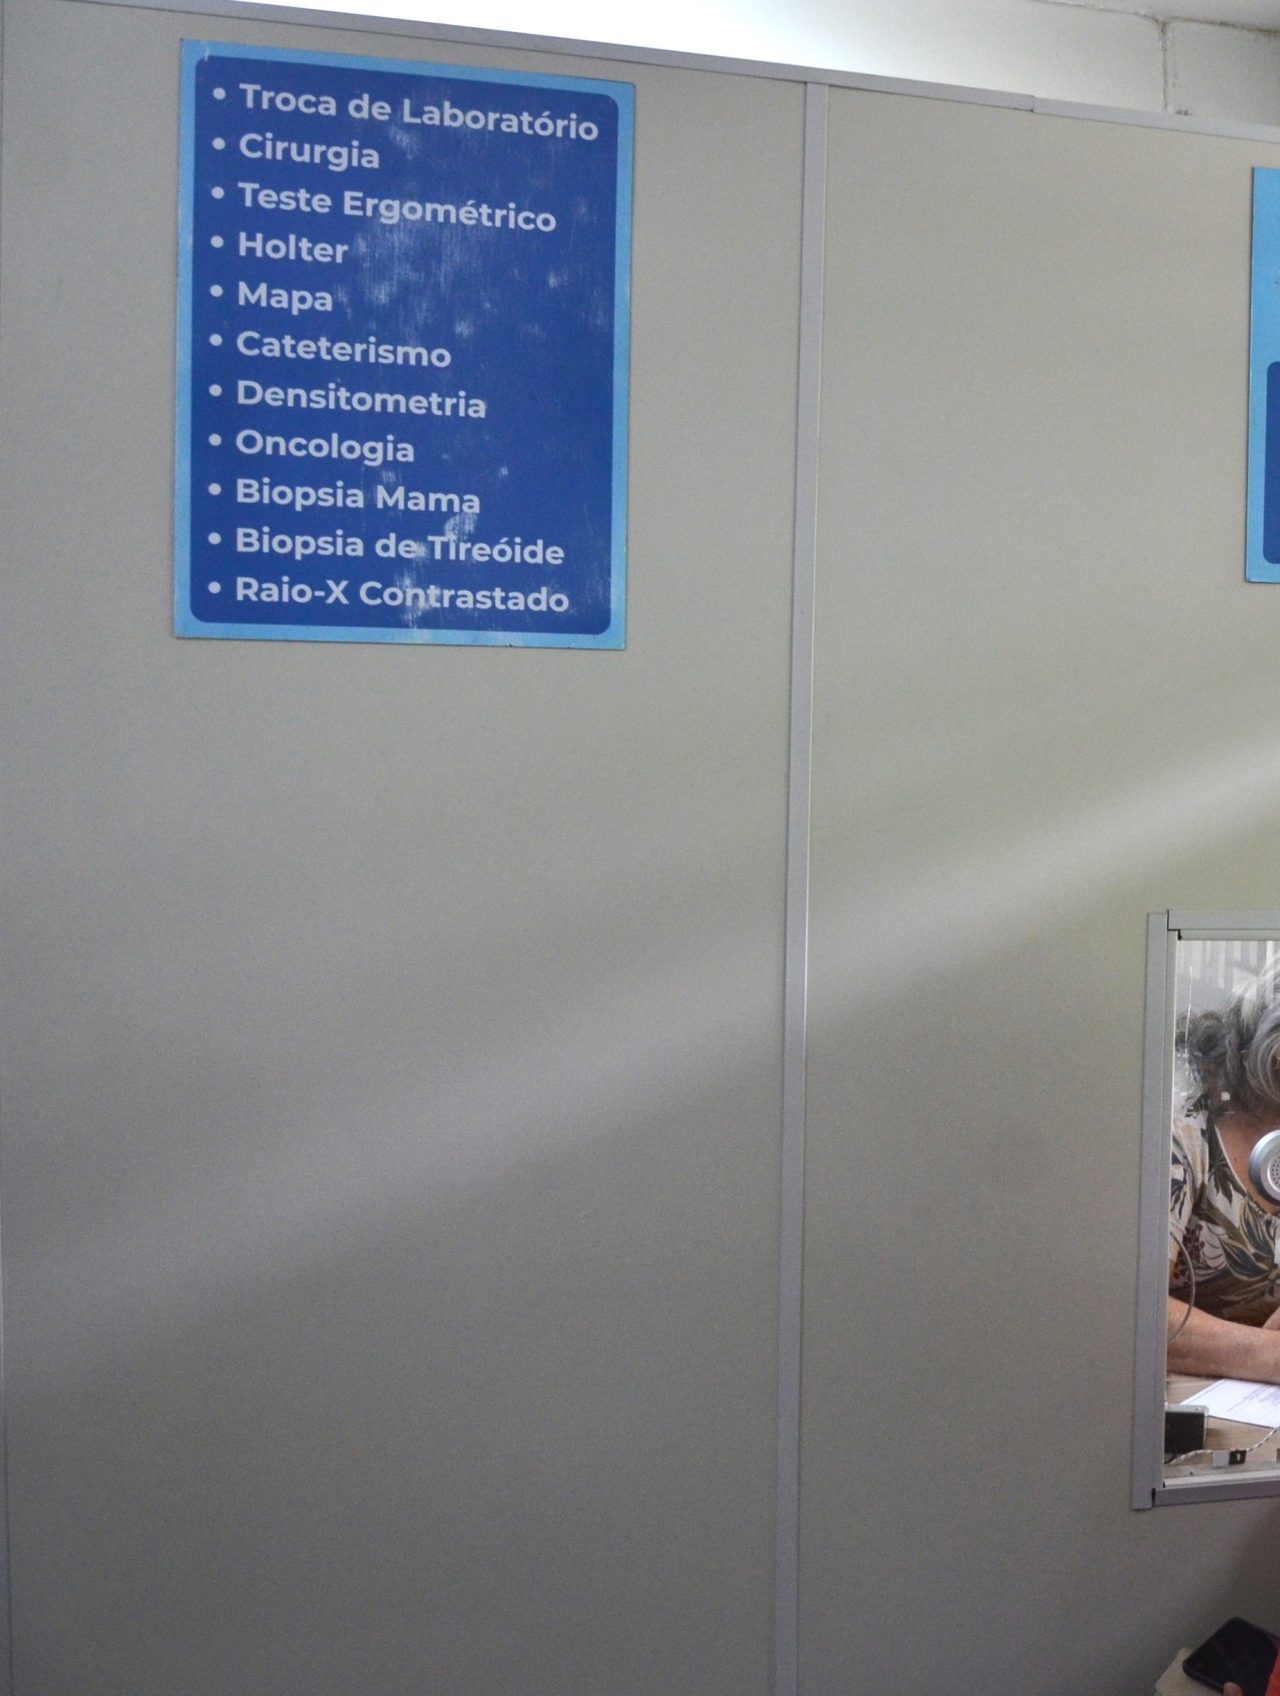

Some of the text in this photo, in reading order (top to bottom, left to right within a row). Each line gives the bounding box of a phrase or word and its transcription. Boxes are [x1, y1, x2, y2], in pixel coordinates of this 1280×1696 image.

[238, 83, 600, 141] Troca de Laboratório
[239, 132, 381, 172] Cirurgia
[238, 182, 558, 233] Teste Ergométrico
[238, 231, 350, 264] Holter
[238, 281, 333, 316] Mapa
[236, 330, 452, 368] Cateterismo
[236, 380, 487, 419] Densitometria
[235, 429, 415, 467] Oncologia
[236, 478, 482, 514] Biopsia Mama
[236, 527, 566, 566] Biopsia de Tireóide
[236, 576, 570, 613] Raio-X Contrastado
